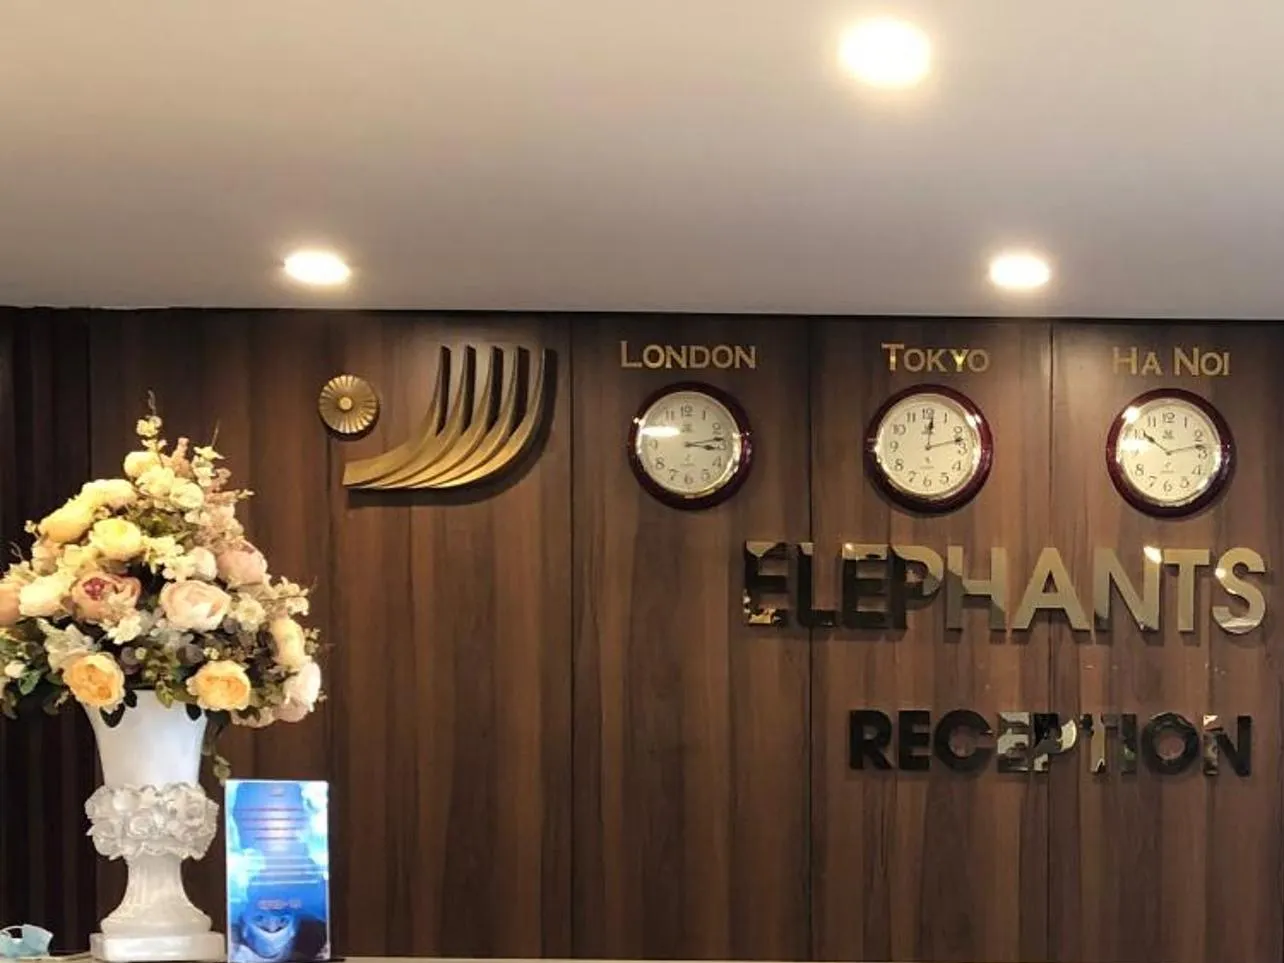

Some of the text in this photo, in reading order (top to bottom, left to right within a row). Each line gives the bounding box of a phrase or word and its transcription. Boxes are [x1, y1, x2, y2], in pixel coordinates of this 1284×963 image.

[1162, 412, 1175, 423] 12
[1135, 464, 1144, 476] 8
[1163, 480, 1172, 492] 6
[743, 541, 1267, 634] ELEPHANTS
[848, 709, 1252, 777] RECEPTION
